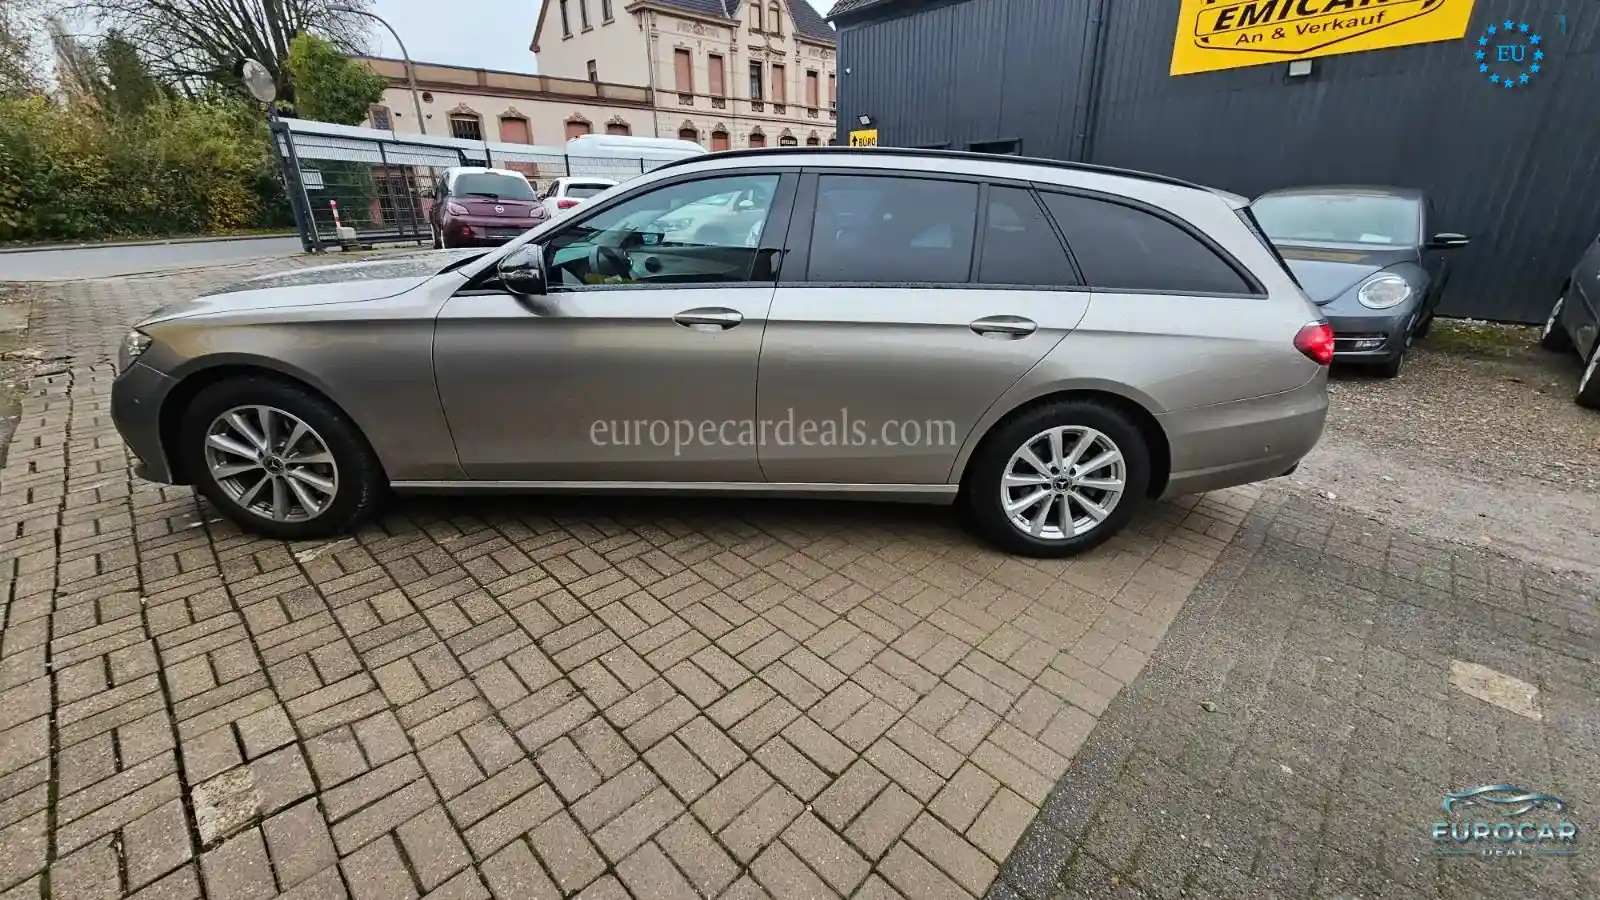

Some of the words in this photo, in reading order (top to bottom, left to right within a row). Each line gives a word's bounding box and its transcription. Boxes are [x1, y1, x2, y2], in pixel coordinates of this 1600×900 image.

[1213, 0, 1392, 31] EMICA
[1236, 33, 1263, 46] An
[1272, 28, 1286, 40] &
[1296, 11, 1384, 36] Verkauf
